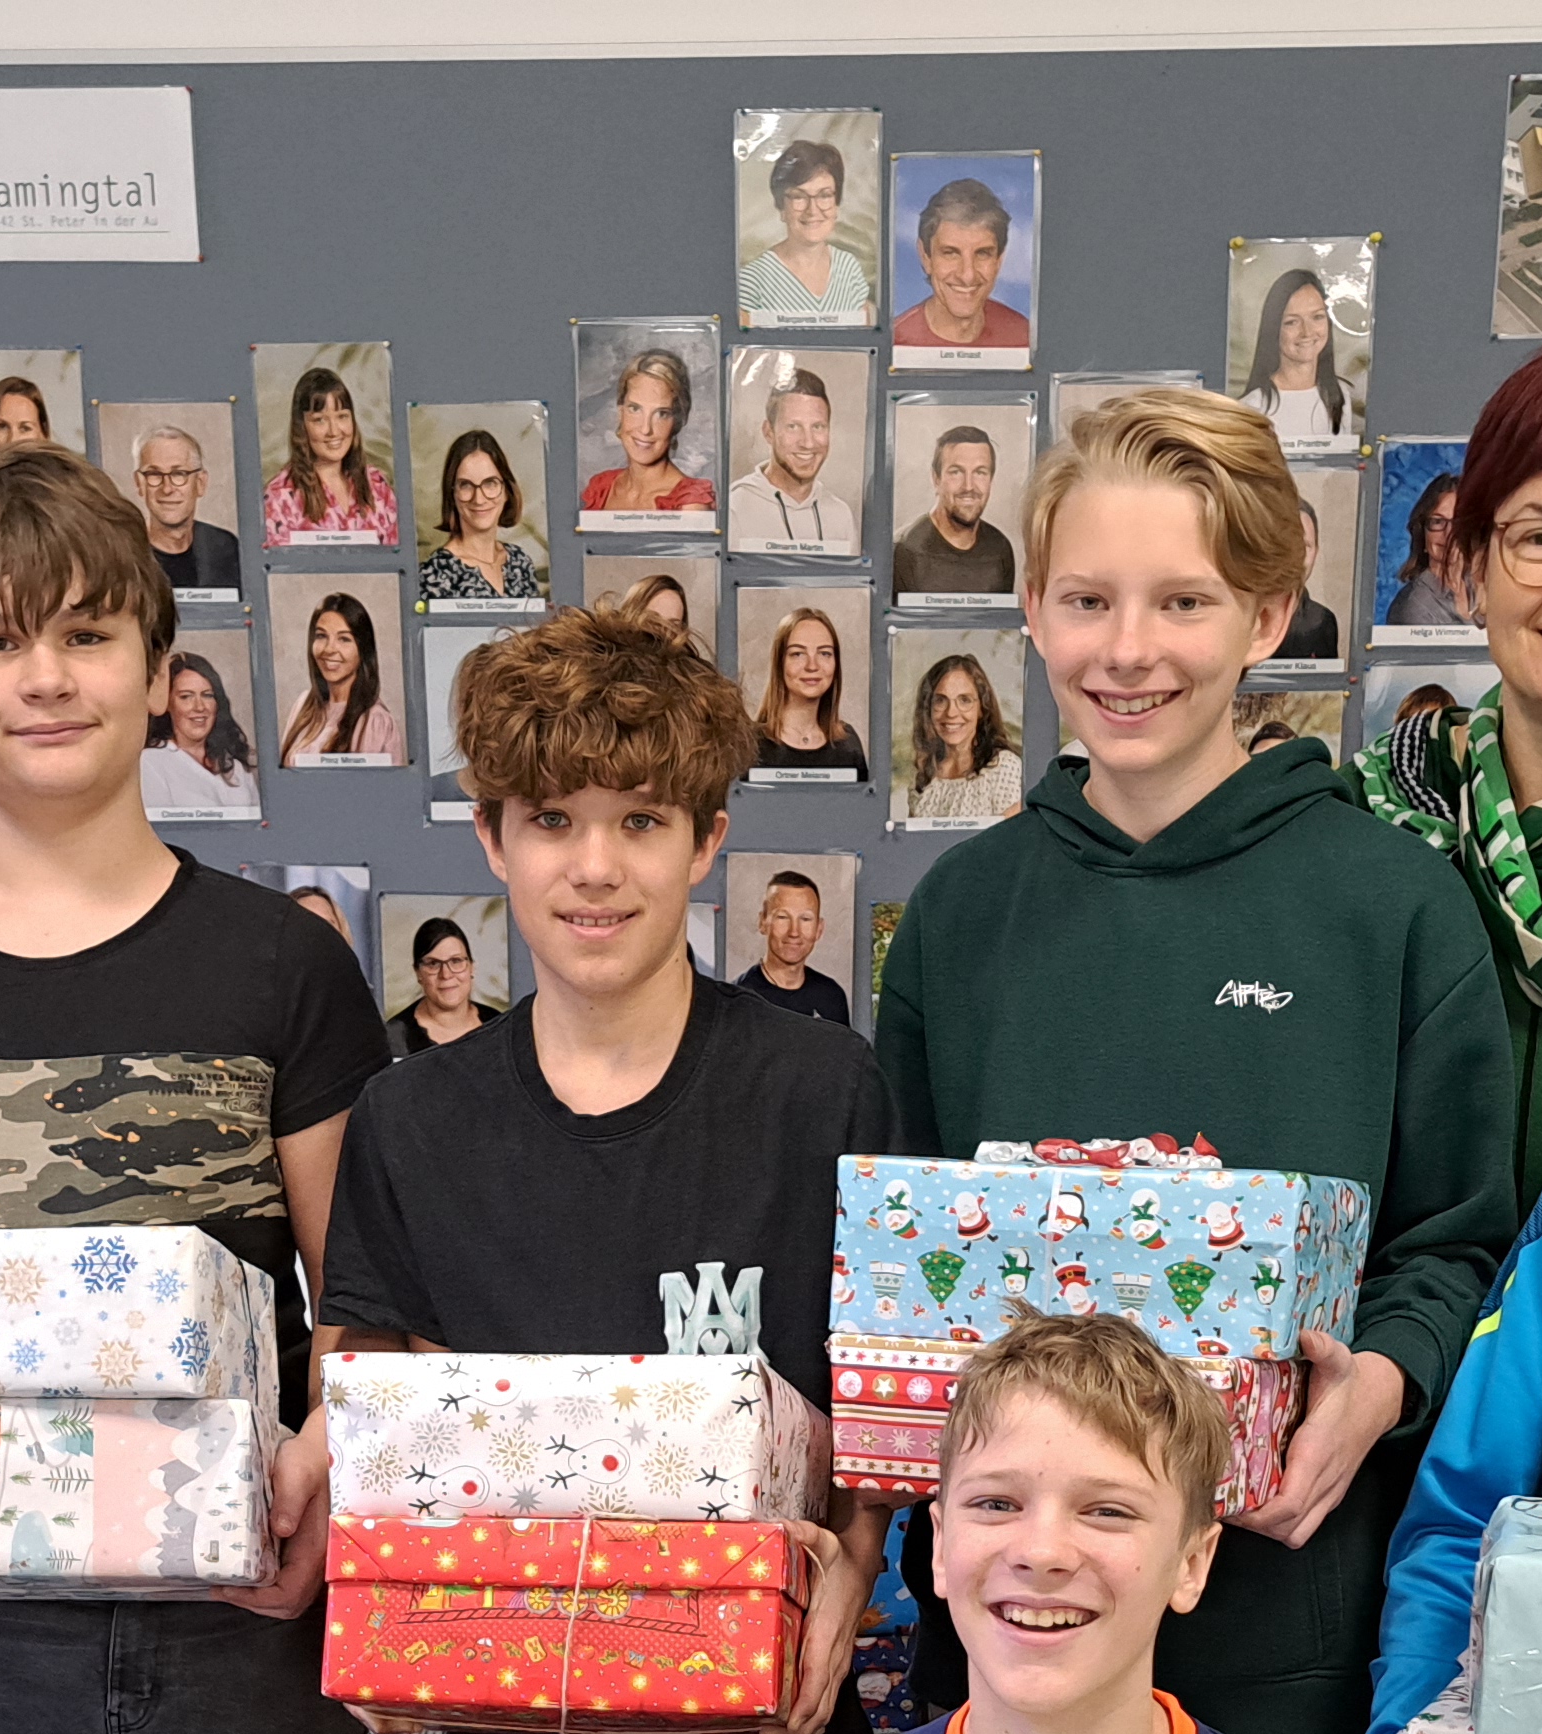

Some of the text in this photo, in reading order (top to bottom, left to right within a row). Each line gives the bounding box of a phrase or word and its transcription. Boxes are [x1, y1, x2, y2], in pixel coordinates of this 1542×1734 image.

[50, 214, 86, 228] Peter
[114, 214, 135, 228] der
[1410, 629, 1433, 638] Helga
